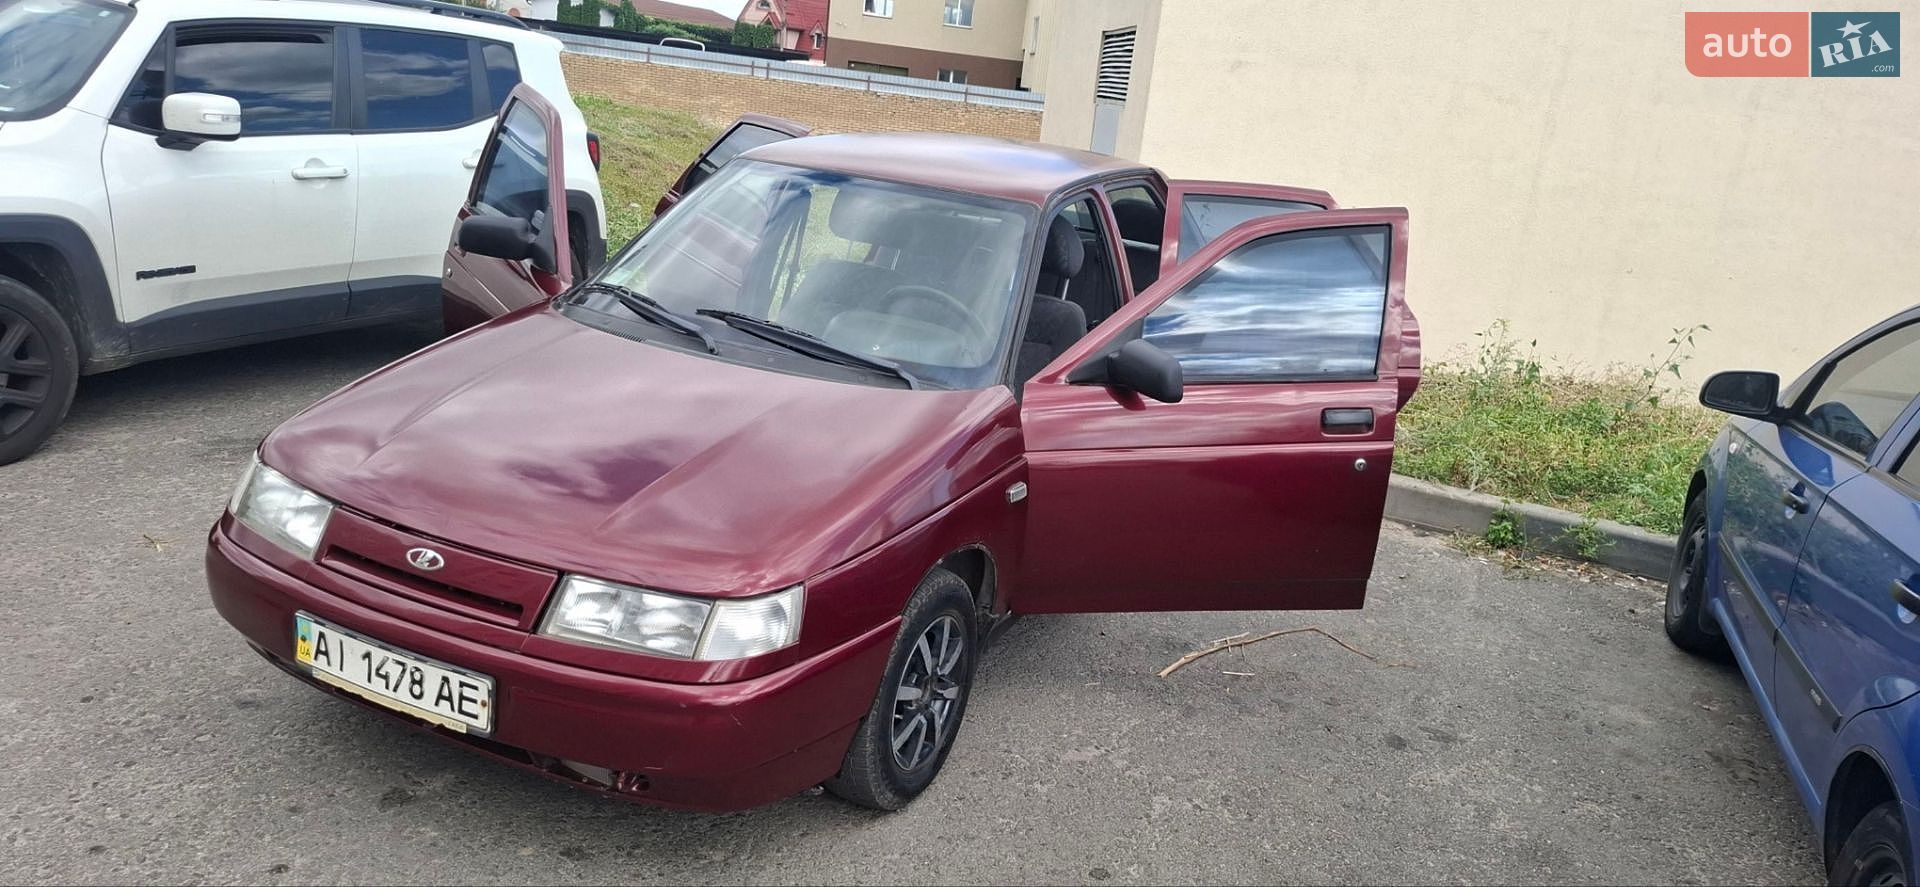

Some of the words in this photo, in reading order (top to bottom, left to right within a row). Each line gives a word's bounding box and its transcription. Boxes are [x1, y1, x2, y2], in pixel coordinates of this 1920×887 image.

[299, 644, 311, 658] UA
[313, 630, 344, 672] AI
[361, 652, 425, 701] 1478
[434, 675, 480, 720] AE
